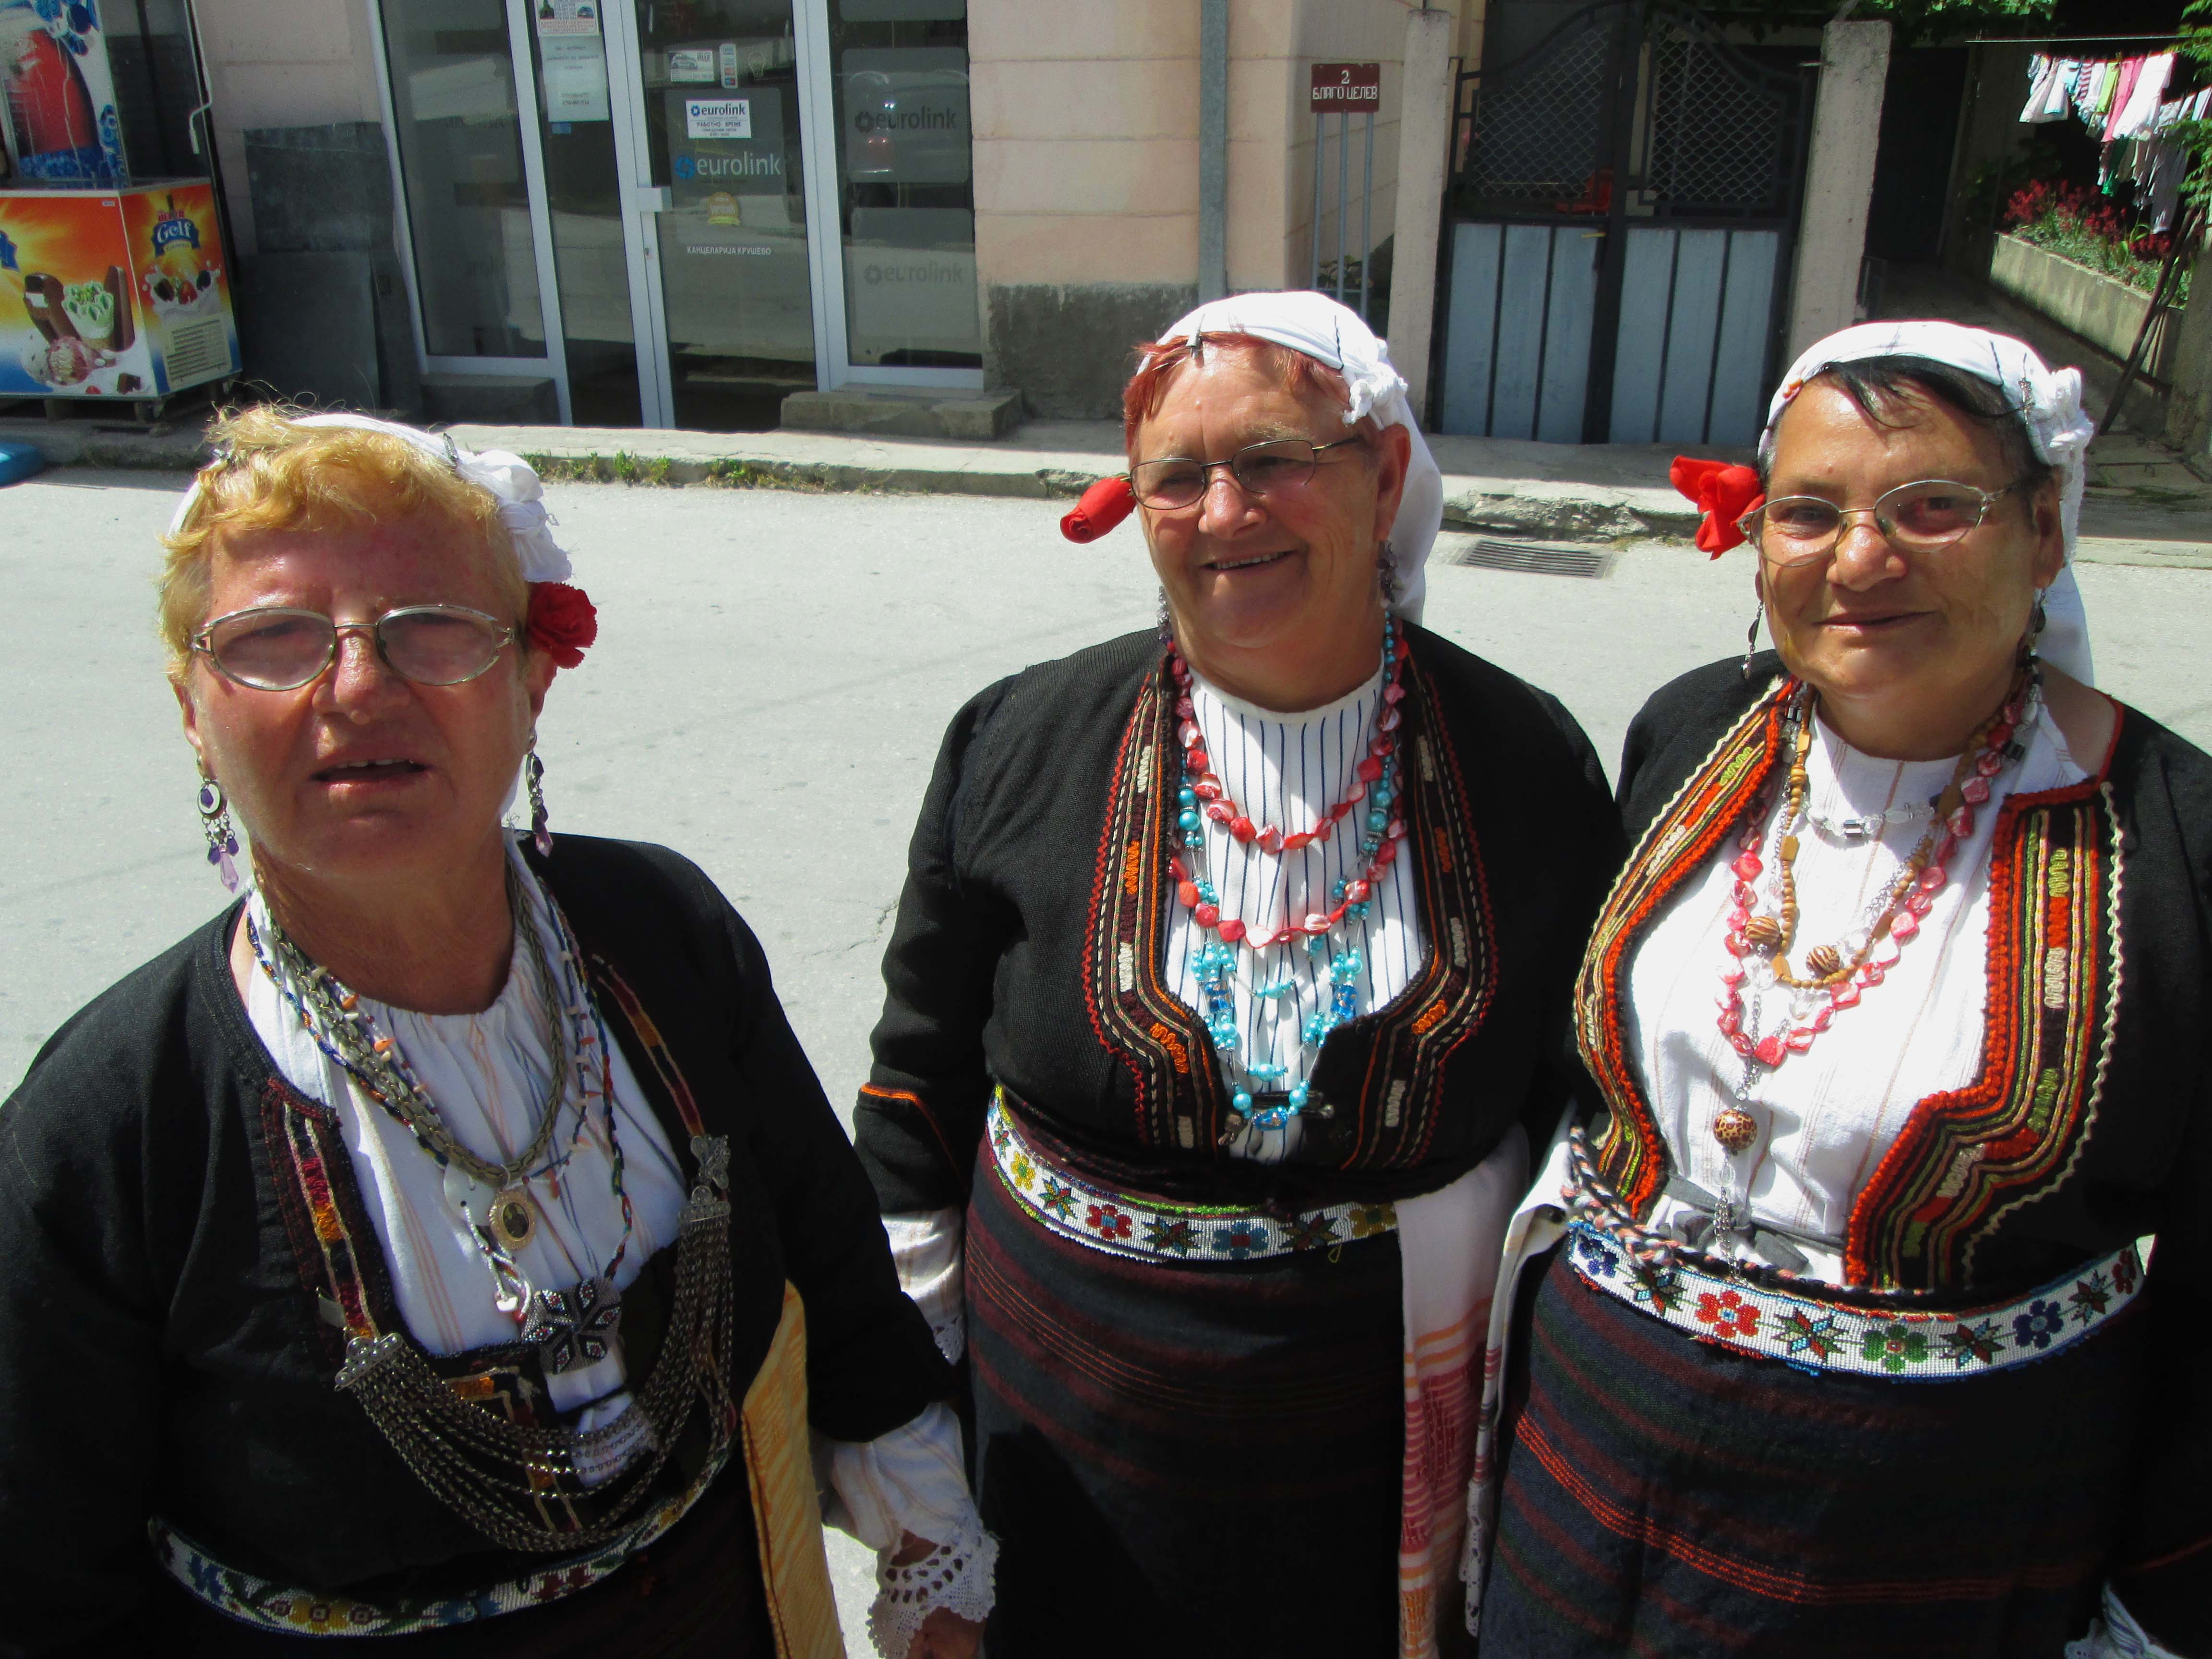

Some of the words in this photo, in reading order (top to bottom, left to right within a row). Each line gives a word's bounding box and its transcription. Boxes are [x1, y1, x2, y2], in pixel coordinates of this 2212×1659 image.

[1341, 70, 1350, 84] 2
[1313, 87, 1344, 99] БЛАГО
[1346, 86, 1377, 99] ЦЕЛЕВ
[701, 103, 745, 115] eurolink
[875, 106, 957, 130] eurolink
[697, 151, 781, 175] eurolink
[157, 221, 192, 243] Golf
[687, 246, 736, 255] КАНЦЕЛАРИЈА
[737, 247, 771, 255] КРУШЕВО
[884, 262, 964, 284] eurolink
